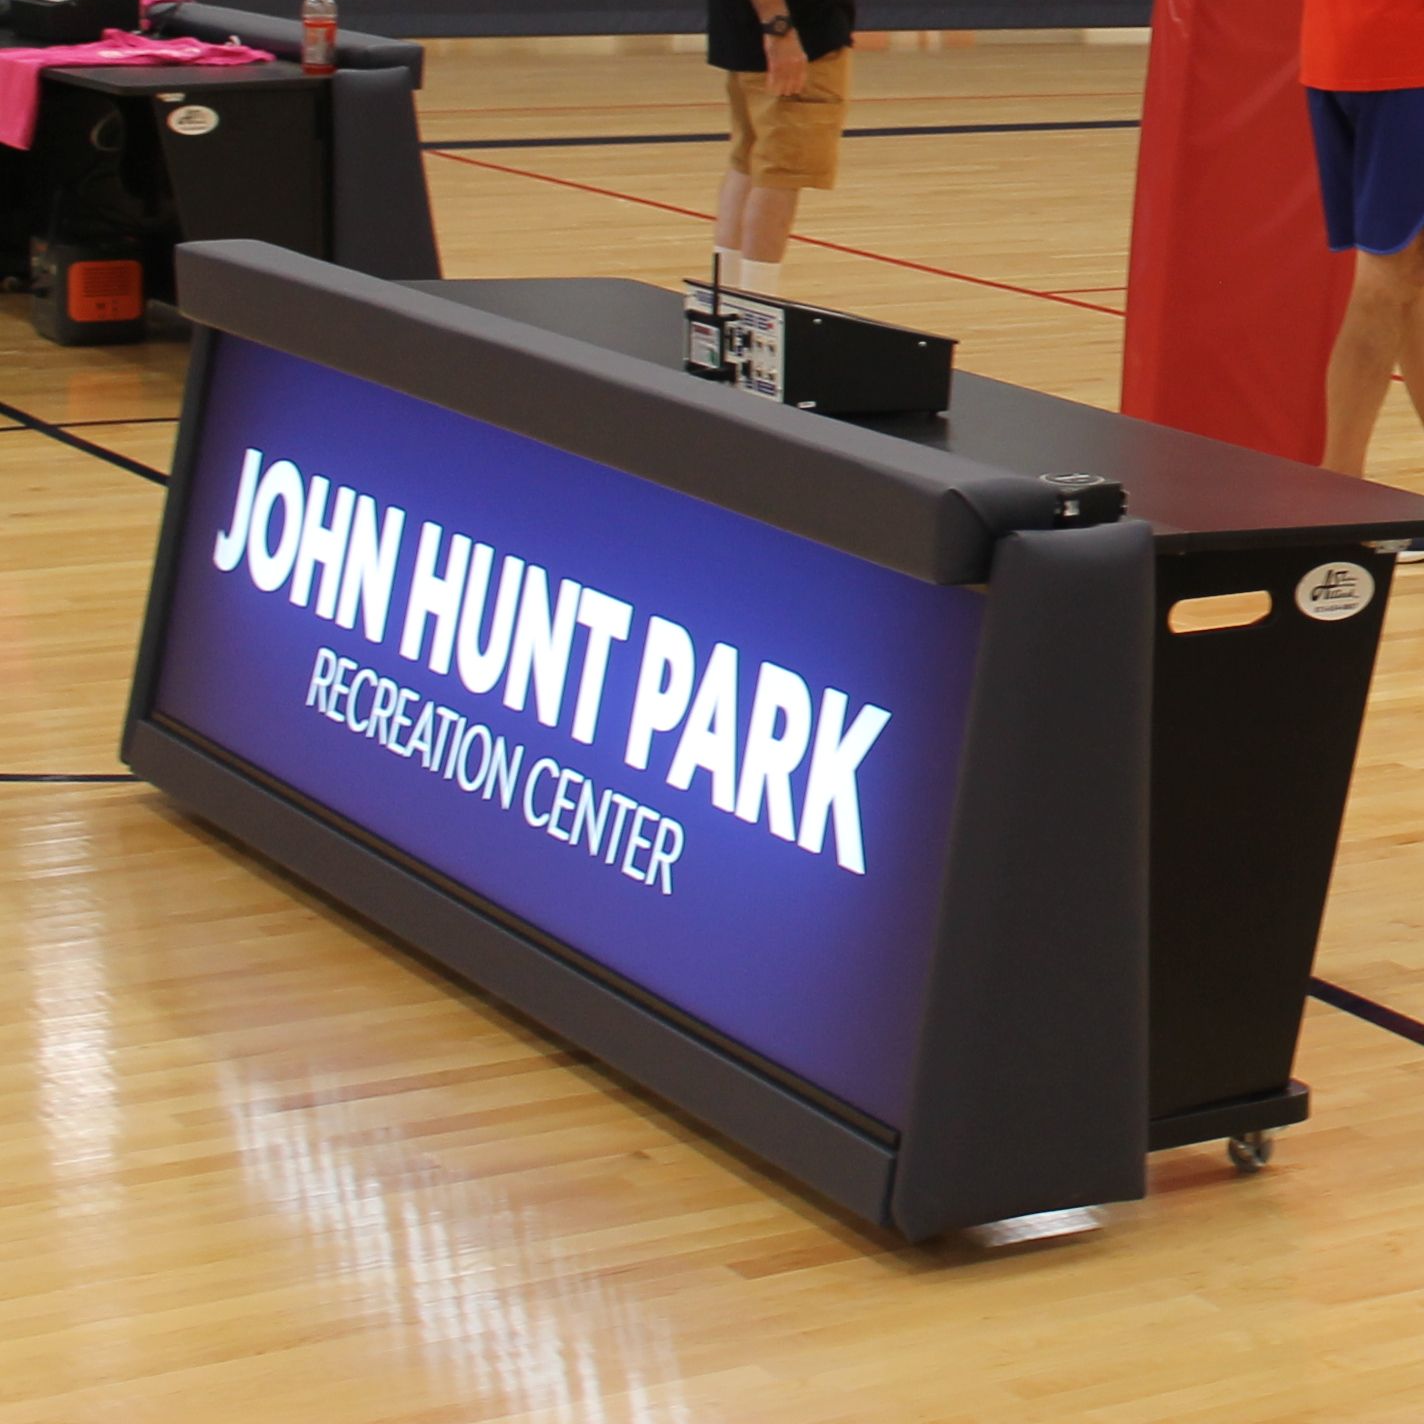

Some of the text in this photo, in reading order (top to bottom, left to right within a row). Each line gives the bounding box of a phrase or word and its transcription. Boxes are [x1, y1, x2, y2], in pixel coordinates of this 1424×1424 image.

[213, 448, 892, 875] JOHN HUNT PARK
[305, 648, 684, 896] RECREATION CENTER
